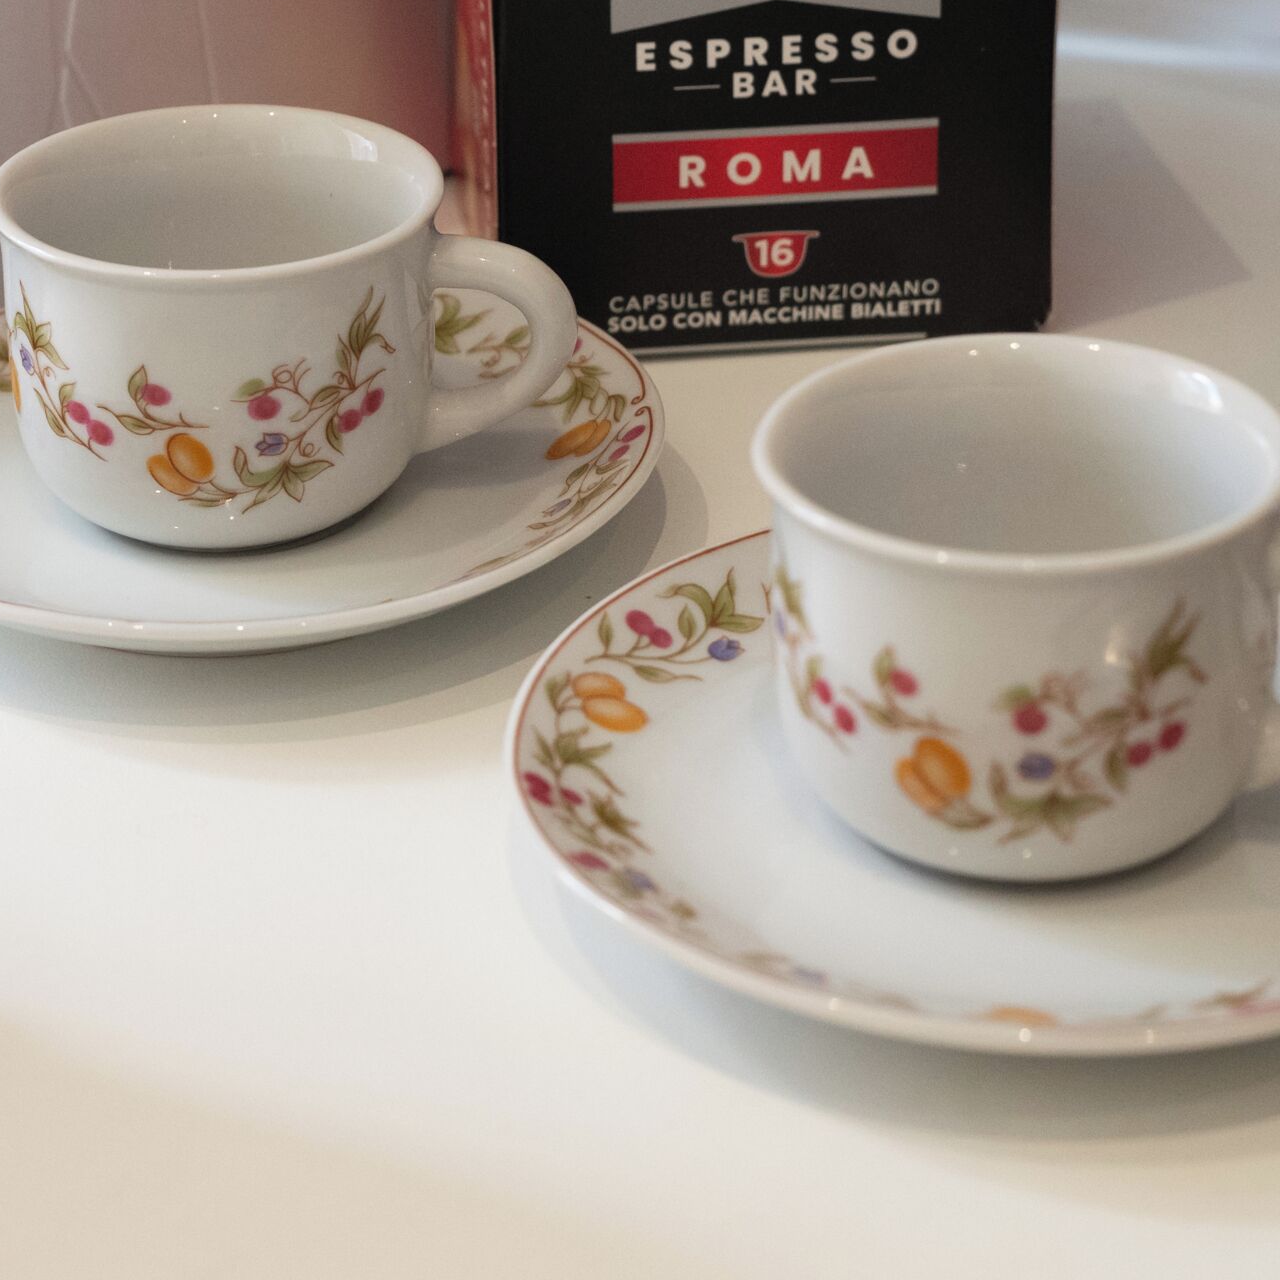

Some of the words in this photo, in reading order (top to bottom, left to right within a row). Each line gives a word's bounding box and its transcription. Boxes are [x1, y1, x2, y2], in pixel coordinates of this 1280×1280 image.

[635, 28, 918, 71] ESPRESSO
[732, 68, 818, 99] BAR
[678, 146, 874, 188] ROMA
[754, 237, 795, 268] 16
[609, 290, 714, 314] CAPSULE
[722, 287, 770, 307] CHE
[779, 277, 941, 303] FUNZIONANO
[607, 314, 667, 334] SOLO
[673, 311, 721, 330] CON
[728, 303, 845, 326] MACCHINE
[851, 297, 943, 320] BIALETTI
